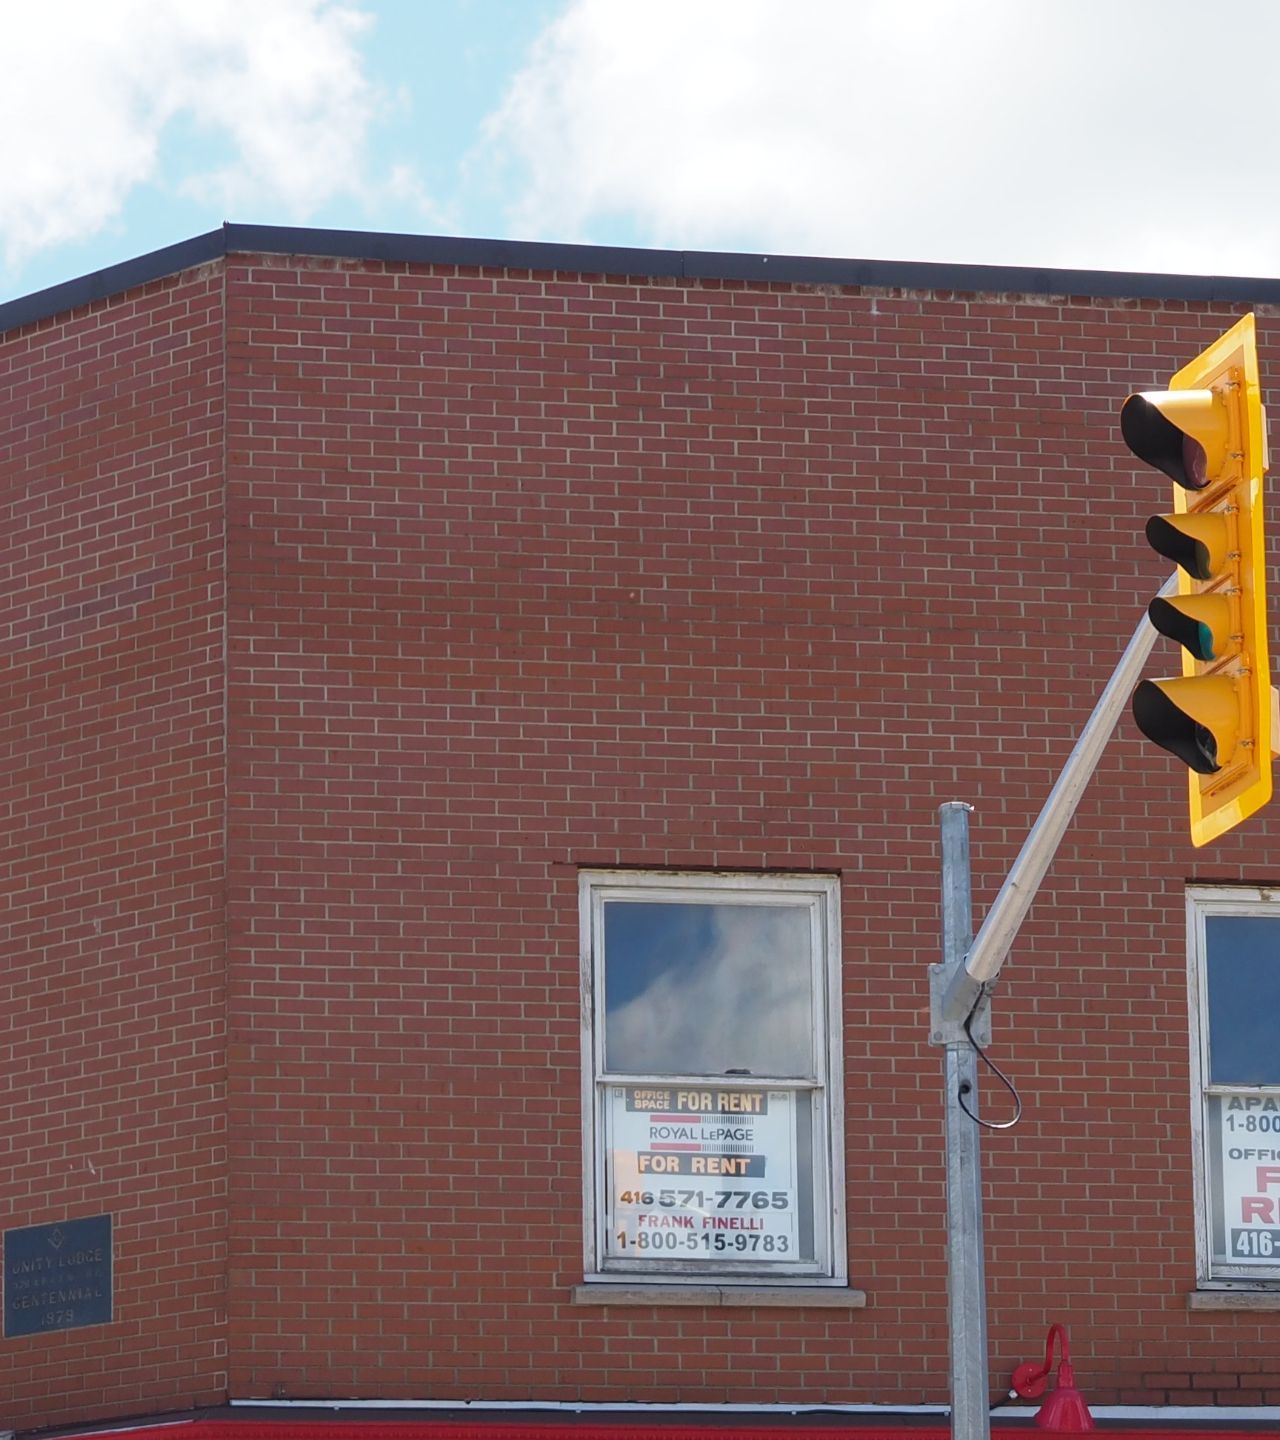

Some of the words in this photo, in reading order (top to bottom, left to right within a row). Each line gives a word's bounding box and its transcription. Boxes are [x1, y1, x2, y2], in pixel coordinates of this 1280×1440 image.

[634, 1089, 669, 1100] OFFICE
[677, 1092, 712, 1111] FOR
[718, 1093, 762, 1113] RENT
[634, 1100, 669, 1110] SPACE
[649, 1127, 698, 1140] ROYAL
[639, 1155, 680, 1173] FOR
[691, 1156, 750, 1174] RENT
[620, 1191, 654, 1205] 416
[658, 1189, 789, 1210] 571-7765
[638, 1214, 694, 1229] FRANK
[702, 1216, 764, 1230] FINELLI
[616, 1231, 789, 1253] 1-800-515-9783
[12, 1257, 51, 1274] UNITY
[59, 1248, 103, 1267] LODGE
[12, 1287, 102, 1309] CENTENNIAL
